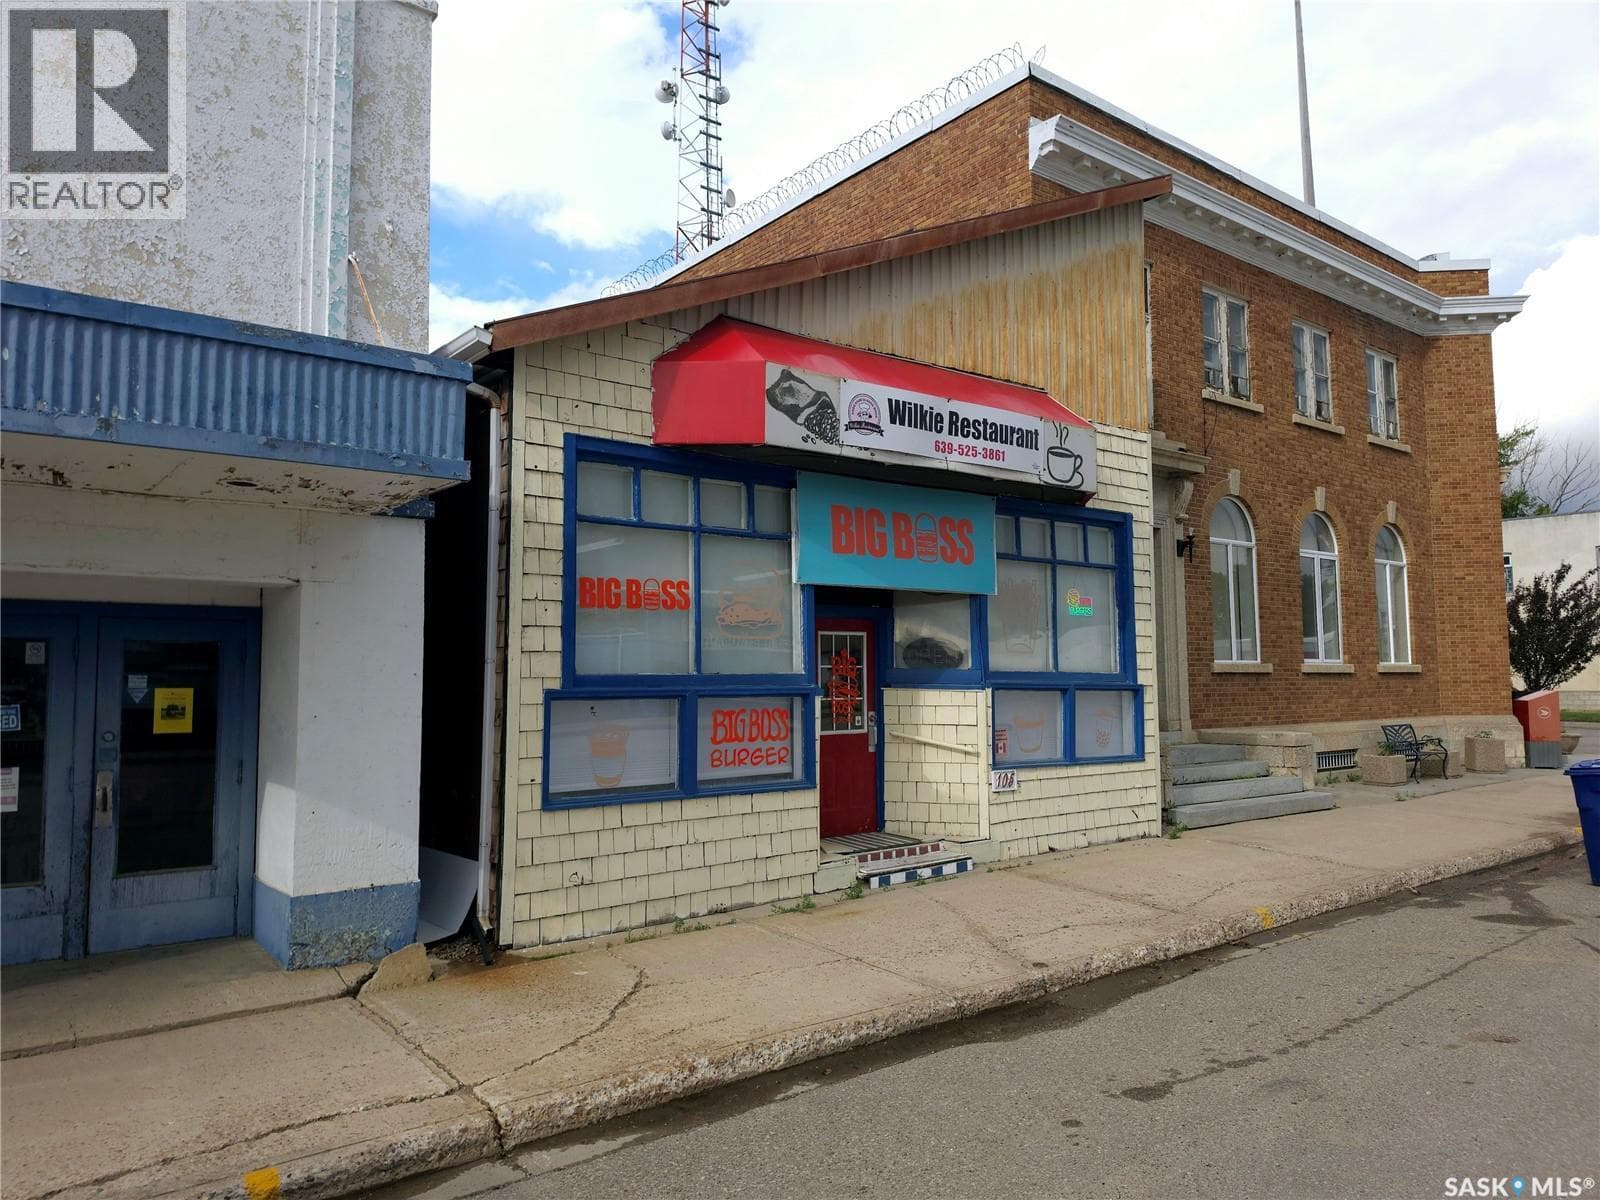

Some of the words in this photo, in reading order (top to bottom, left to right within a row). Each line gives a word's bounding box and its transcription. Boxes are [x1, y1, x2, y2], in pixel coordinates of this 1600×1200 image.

[887, 397, 945, 435] Wilkie
[947, 410, 1040, 452] Restaurant
[934, 439, 1006, 463] 639-525-3861
[830, 503, 889, 559] BIG
[578, 576, 623, 610] BIG
[0, 715, 17, 729] ED
[710, 708, 746, 746] BIG
[749, 707, 791, 744] BOSS
[710, 746, 790, 769] BURGER
